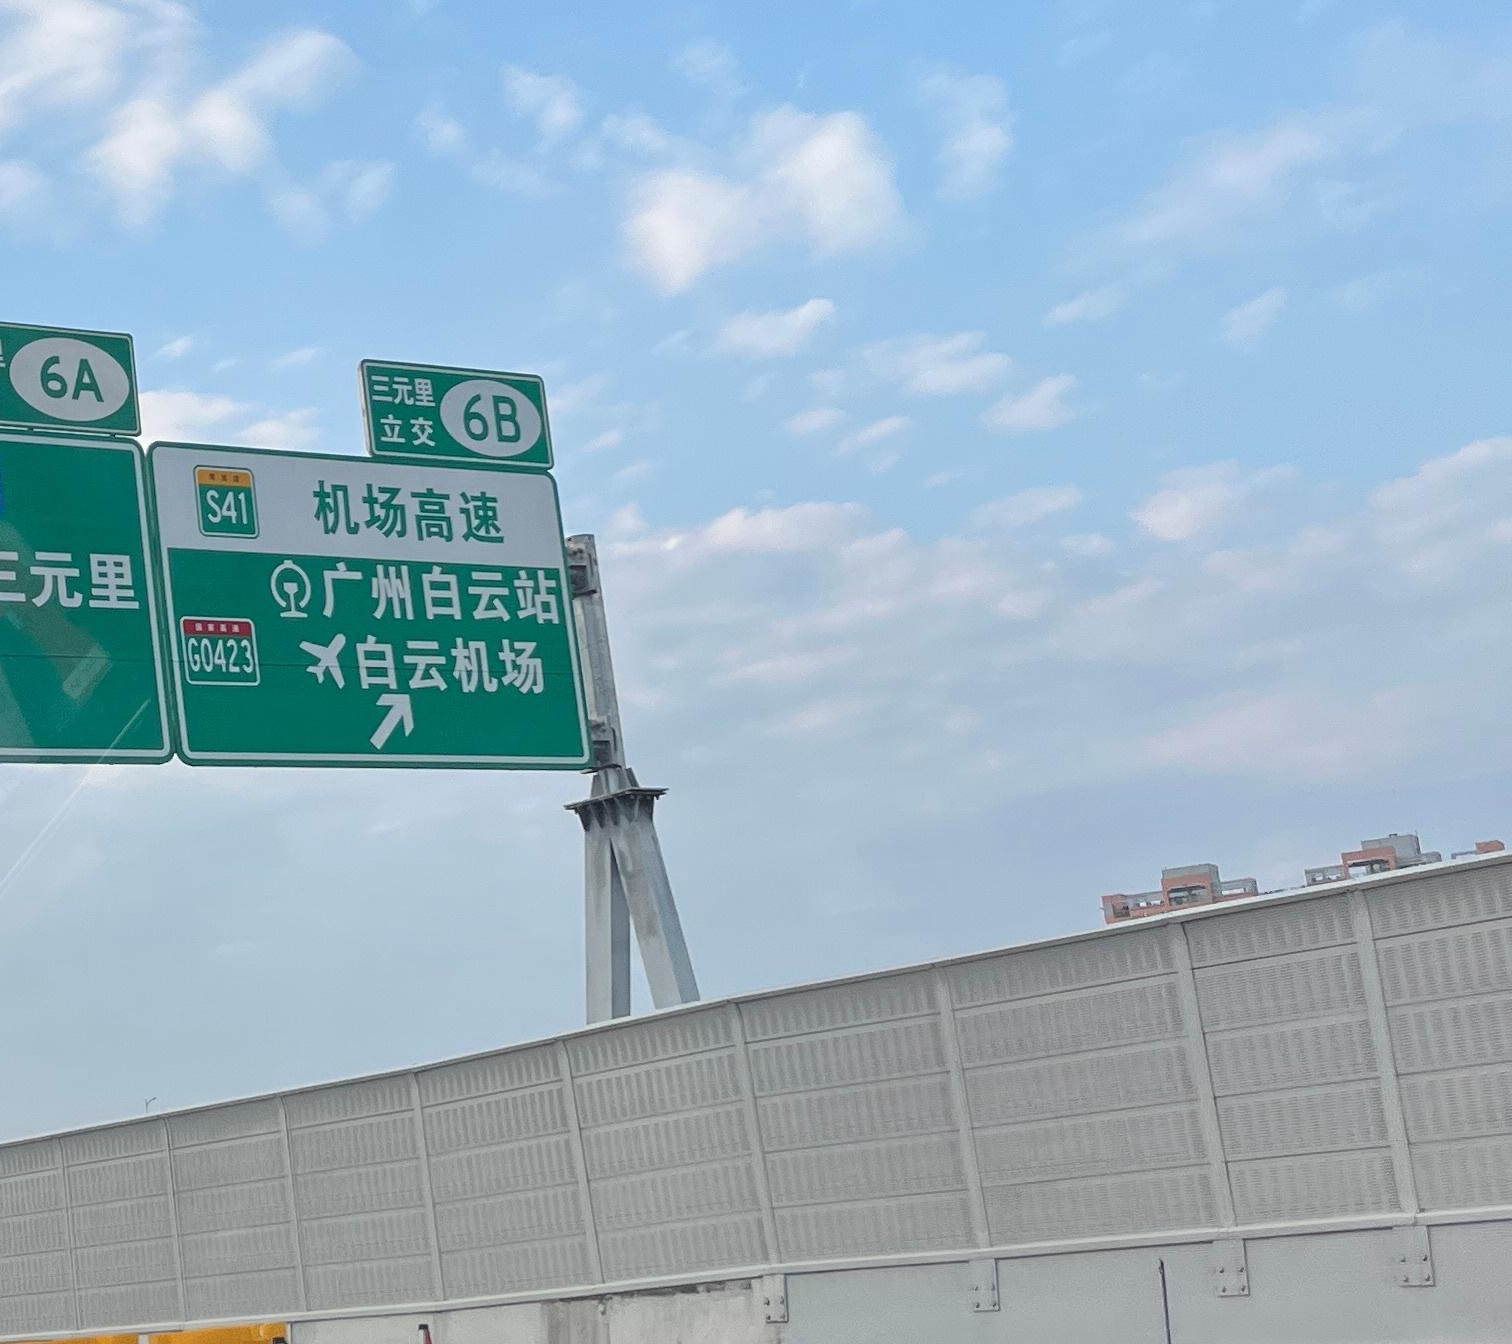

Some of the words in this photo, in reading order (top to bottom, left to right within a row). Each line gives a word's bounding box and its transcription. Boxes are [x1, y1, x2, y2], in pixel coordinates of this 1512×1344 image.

[39, 355, 105, 403] 6A
[370, 375, 436, 408] 三元里
[379, 414, 436, 447] 立交
[462, 394, 522, 444] 6B
[206, 489, 248, 525] S41
[312, 479, 505, 544] 机场高速
[322, 561, 560, 625] 广州白云站
[187, 637, 254, 673] G0423
[355, 634, 545, 694] 白云机场
